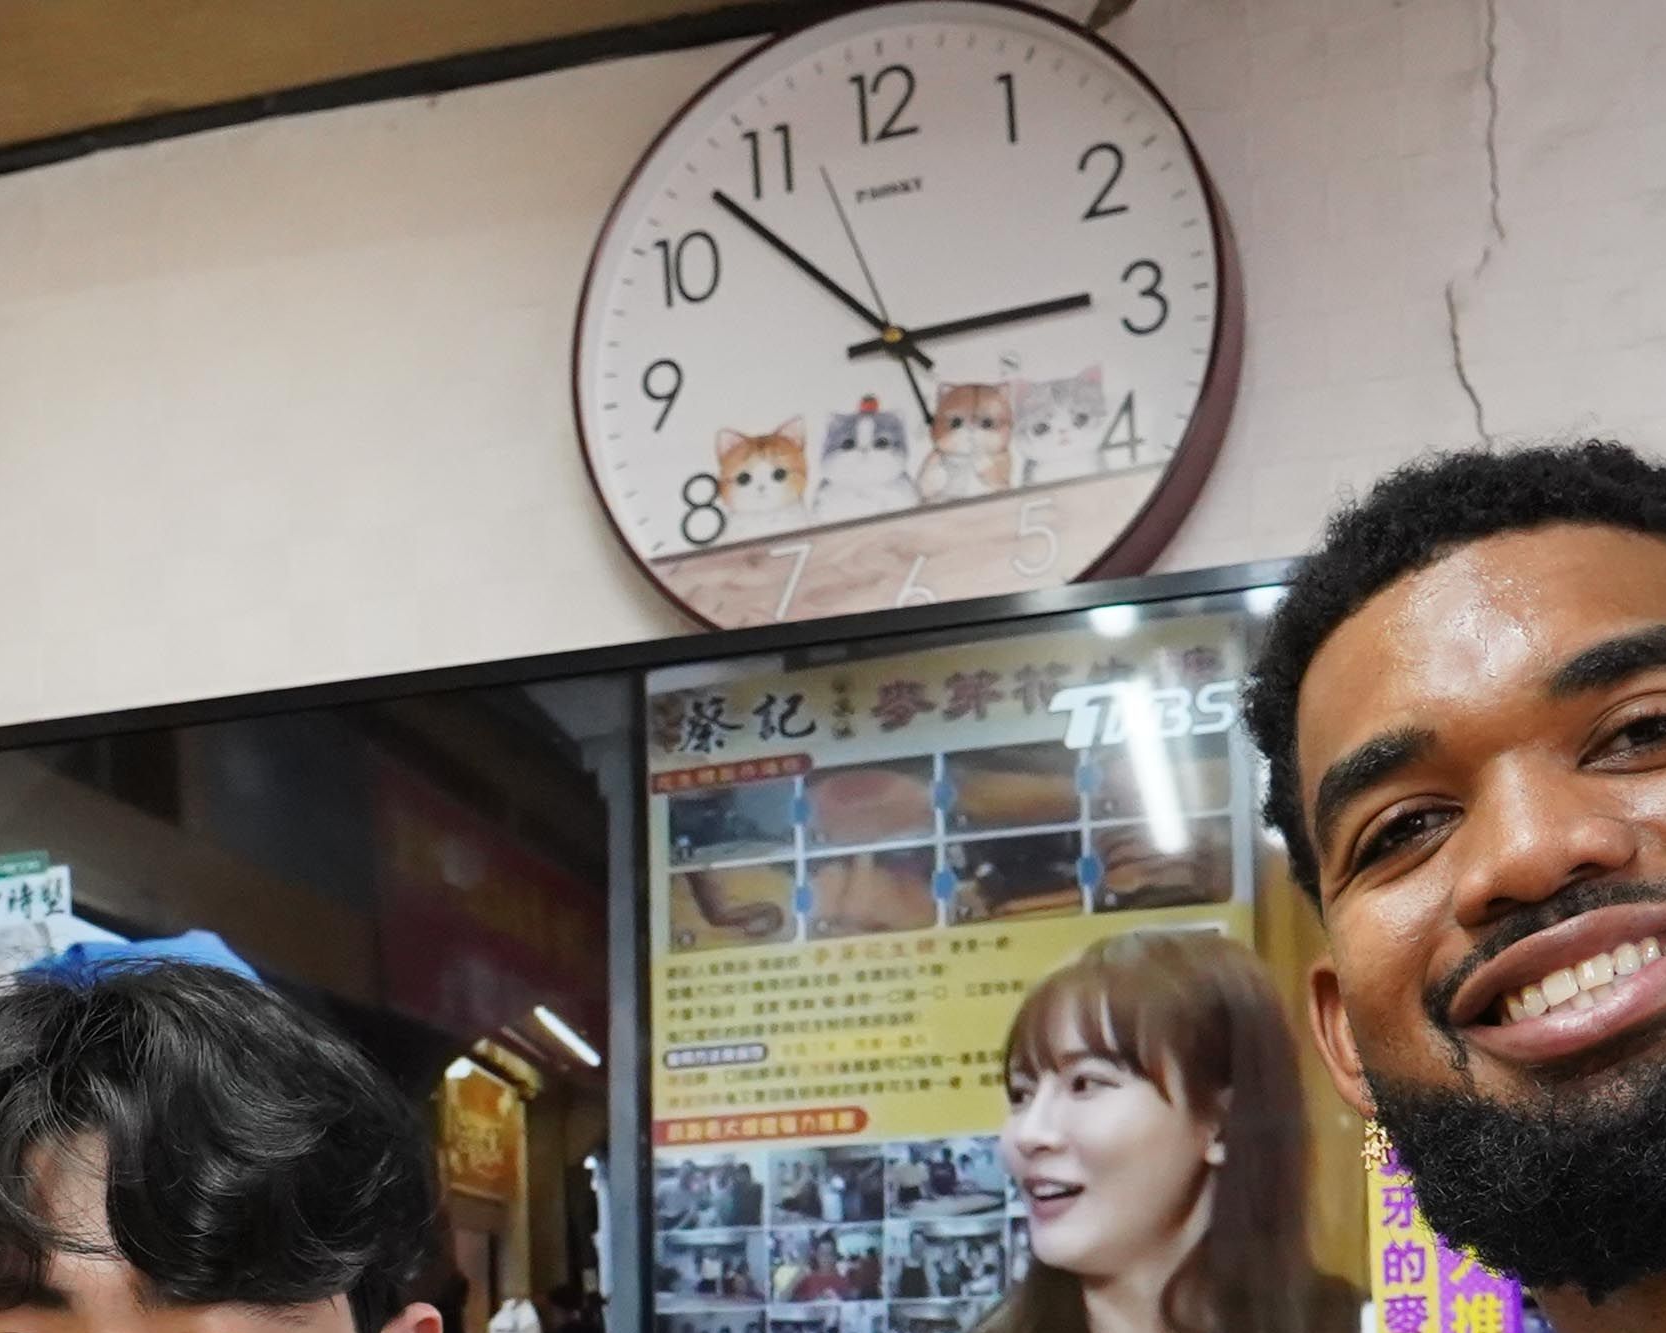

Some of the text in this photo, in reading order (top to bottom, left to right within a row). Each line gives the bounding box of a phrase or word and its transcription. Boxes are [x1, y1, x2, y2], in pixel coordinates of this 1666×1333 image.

[849, 64, 919, 145] 12
[997, 73, 1019, 143] 1
[742, 123, 794, 200] 11
[1078, 143, 1129, 221] 2
[654, 230, 721, 308] 10
[1120, 260, 1169, 335] 3
[642, 359, 684, 432] 9
[1101, 391, 1146, 461] 4
[681, 473, 726, 545] 8
[1010, 499, 1059, 577] 5
[771, 543, 812, 620] 7
